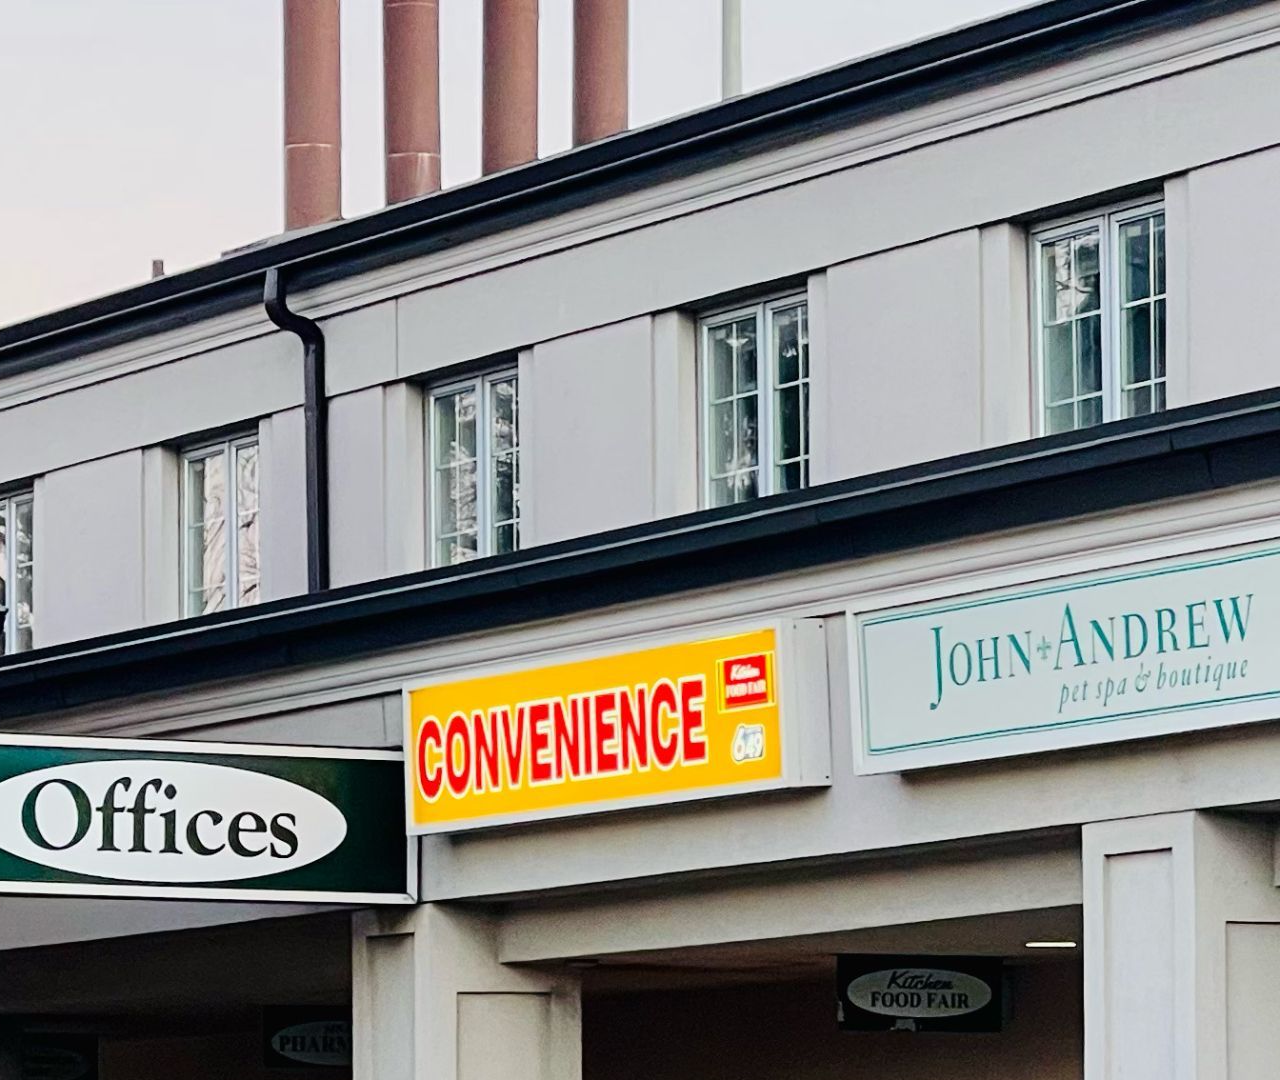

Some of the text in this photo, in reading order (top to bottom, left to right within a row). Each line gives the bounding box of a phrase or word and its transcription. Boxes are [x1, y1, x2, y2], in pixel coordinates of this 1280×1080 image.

[929, 593, 1255, 711] JOHN ANDREW
[1058, 656, 1250, 713] pet spa & boutique
[418, 676, 707, 802] CONVENIENCE
[21, 776, 300, 859] Offices
[871, 991, 970, 1009] FOOD FAIR
